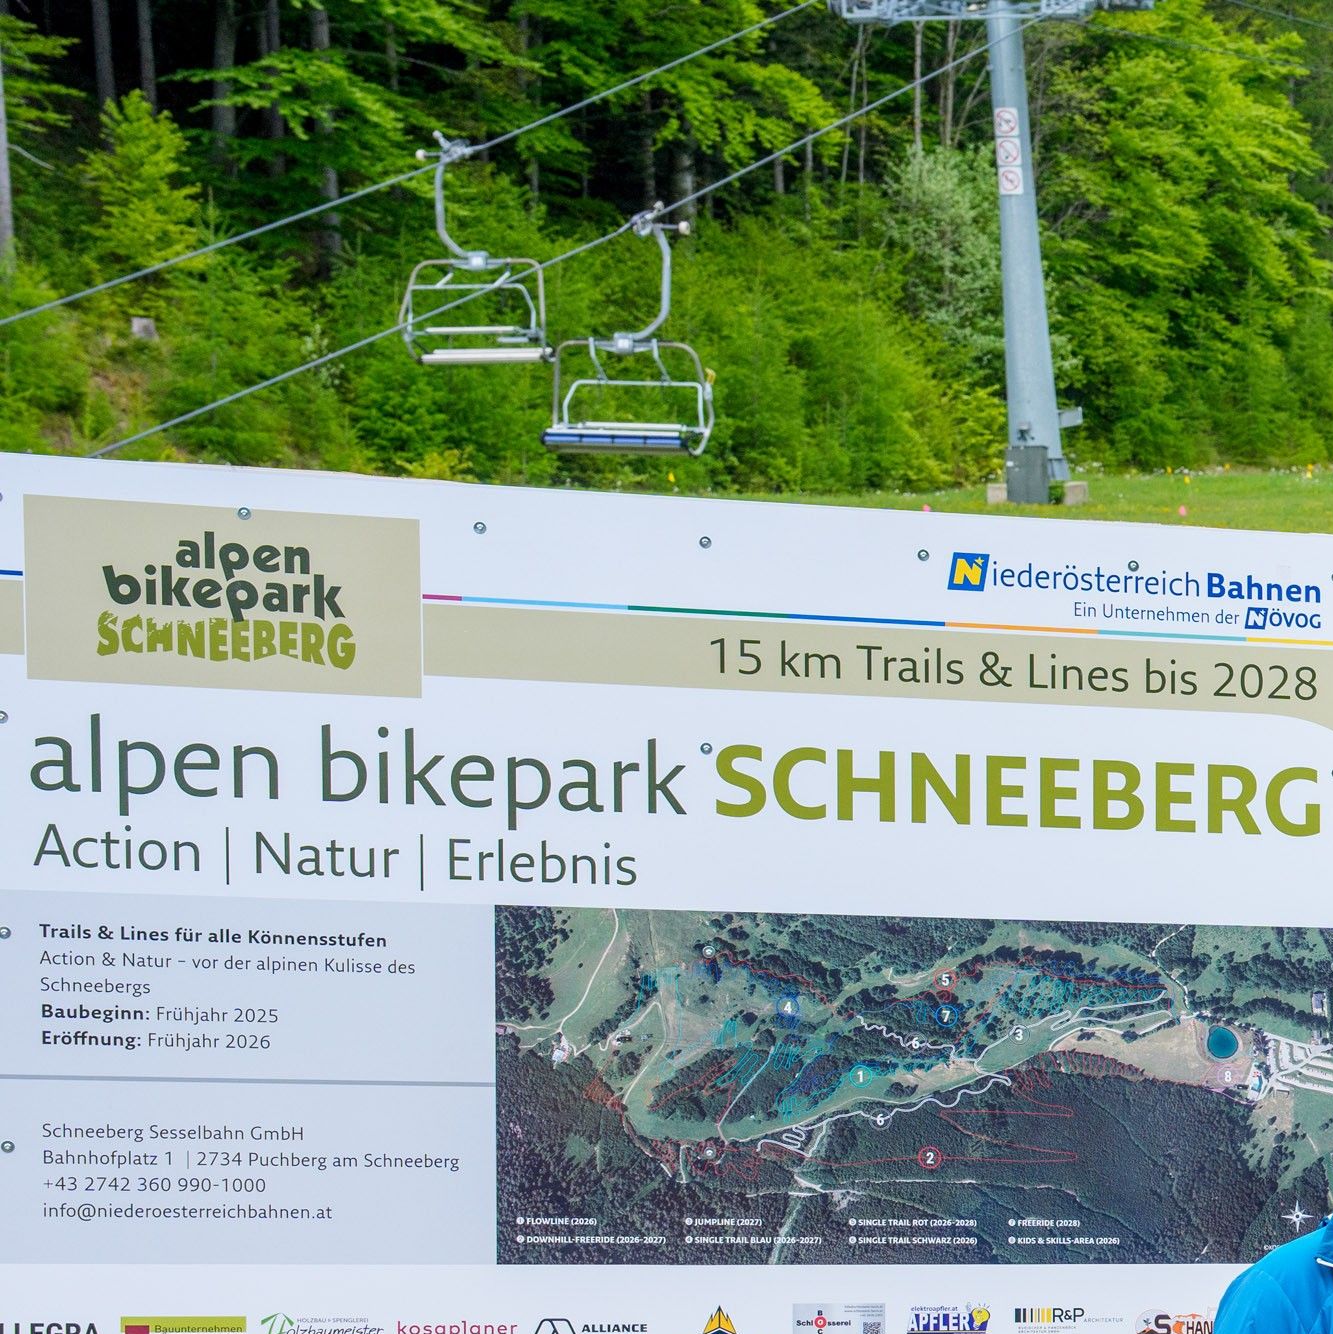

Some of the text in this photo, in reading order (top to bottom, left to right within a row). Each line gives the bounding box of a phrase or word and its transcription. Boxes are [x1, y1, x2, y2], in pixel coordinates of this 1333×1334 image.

[175, 531, 311, 580] alpen
[102, 564, 346, 622] bikepark
[1208, 573, 1320, 603] Bahnen
[1075, 602, 1096, 617] Ein
[1103, 604, 1209, 624] Unternehmen
[1213, 609, 1240, 625] der
[96, 610, 356, 670] SCHNEEBERG
[711, 638, 1317, 700] 15 km Trails & Lines bis 2028
[30, 713, 1320, 837] alpen bikepark SCHNEEBERG
[33, 824, 199, 871] Action
[256, 832, 399, 877] Natur
[449, 839, 636, 885] Erlebnis
[39, 924, 386, 947] Trails & Lines für alle Könnensstufen
[40, 951, 94, 965] Action
[102, 952, 115, 966] &
[123, 953, 171, 967] Natur
[192, 959, 218, 968] vor
[224, 955, 251, 969] der
[257, 956, 317, 974] alpinen
[325, 958, 381, 973] Kulisse
[388, 960, 415, 974] des
[41, 977, 150, 997] Schneebergs
[942, 974, 950, 986] 5
[42, 1004, 278, 1025] Baubeginn: Frühjahr 2025
[784, 1002, 792, 1014] 4
[942, 1011, 950, 1022] 7
[43, 1031, 270, 1051] Eröffnung: Frühjahr 2026
[1015, 1029, 1023, 1040] 3
[912, 1037, 920, 1049] 6
[857, 1071, 864, 1082] 1
[1224, 1071, 1232, 1083] 8
[877, 1114, 885, 1126] 6
[43, 1124, 303, 1142] Schneeberg Sesselbahn GmbH
[44, 1150, 157, 1168] Bahnhofplatz
[165, 1152, 171, 1165] 1
[197, 1152, 241, 1166] 2734
[249, 1153, 326, 1170] Puchberg
[333, 1157, 357, 1167] am
[365, 1154, 459, 1172] Schneeberg
[926, 1151, 935, 1164] 2
[44, 1177, 265, 1192] +43 2742 360 990-1000
[44, 1203, 332, 1221] info@niederoesterreichbahnen.at
[571, 1218, 597, 1226] (2026)
[1056, 1219, 1080, 1227] (2028)
[953, 1237, 977, 1245] (2026)
[1096, 1237, 1120, 1245] (2026)
[908, 1313, 971, 1331] APFLER
[1053, 1308, 1085, 1323] R&P
[154, 1325, 242, 1333] Bauunternehmen
[582, 1324, 647, 1333] ALLIANCE
